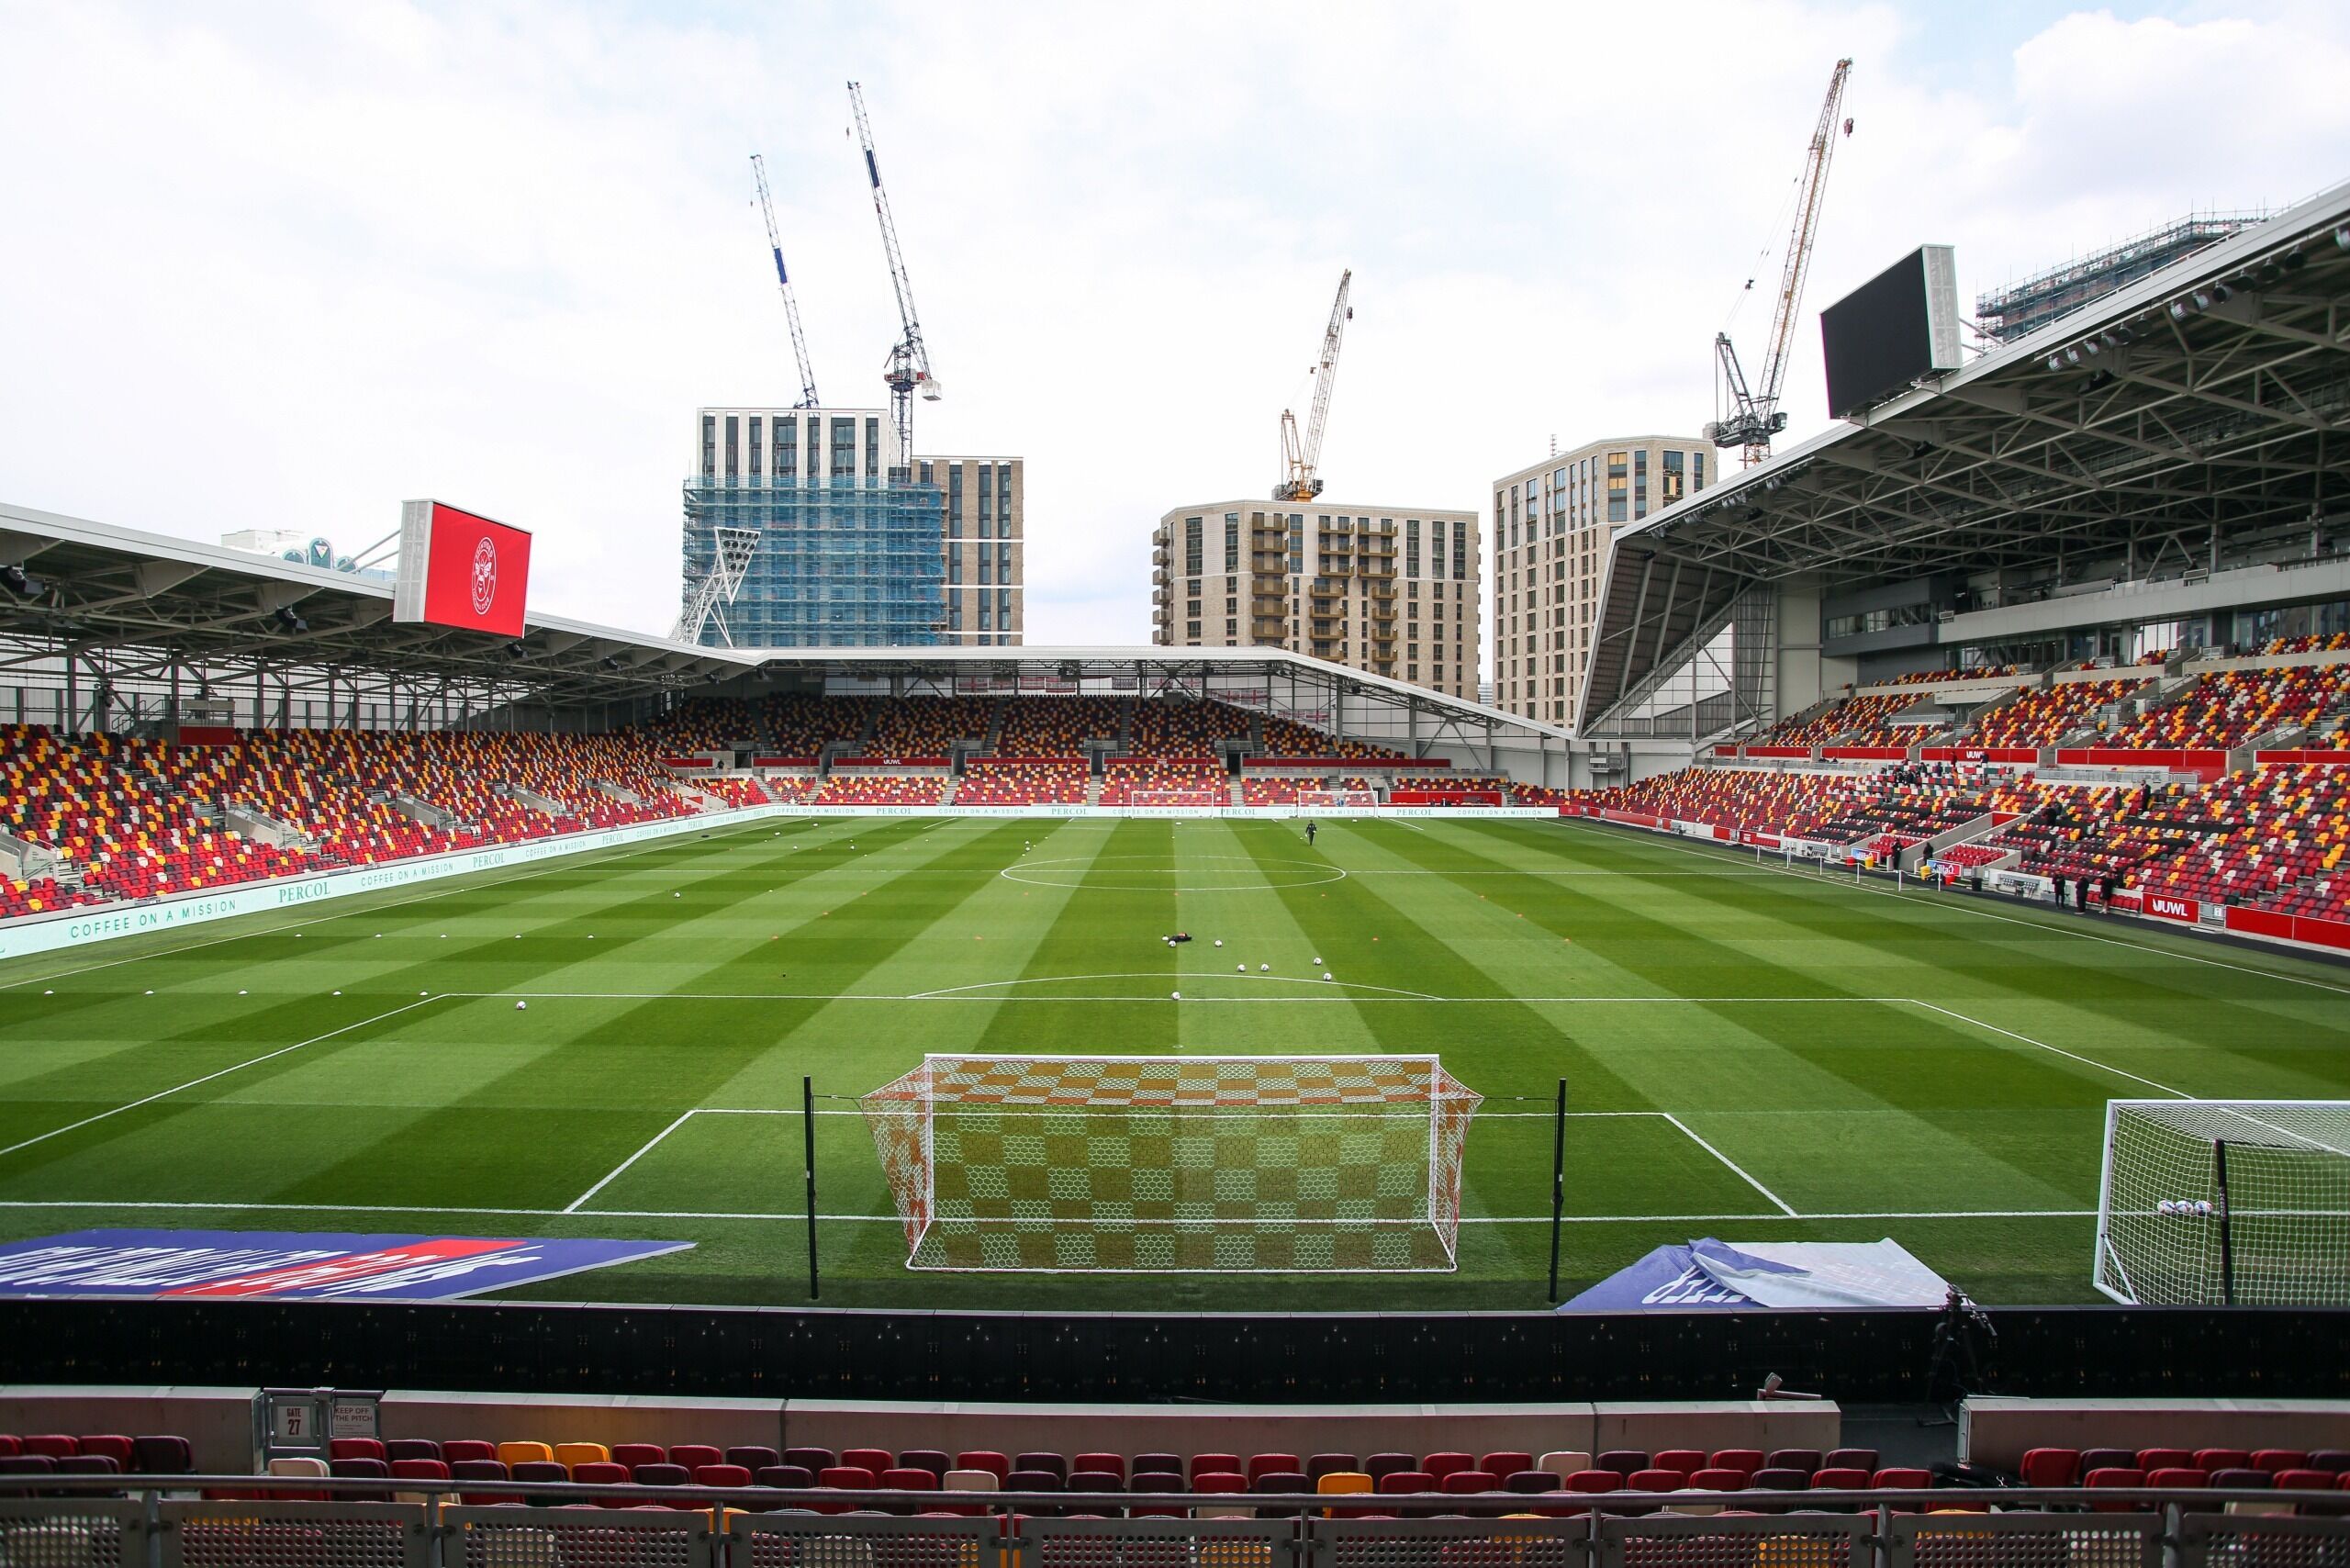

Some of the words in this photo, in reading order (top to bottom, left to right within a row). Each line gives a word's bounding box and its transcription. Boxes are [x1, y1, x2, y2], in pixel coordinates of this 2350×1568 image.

[602, 832, 624, 845] PERCOL
[525, 846, 547, 857] COFFEE
[550, 844, 558, 853] ON
[565, 840, 586, 852] MISSION
[473, 852, 505, 868] PERCOL
[361, 873, 394, 887] COFFEE
[398, 870, 408, 879] ON
[421, 862, 453, 876] MISSION
[279, 881, 330, 902] PERCOL
[71, 917, 129, 938] COFFEE
[140, 913, 157, 926] ON
[167, 911, 173, 921] A
[183, 900, 236, 918] MISSION
[286, 1408, 301, 1417] GATE
[288, 1419, 301, 1435] 27
